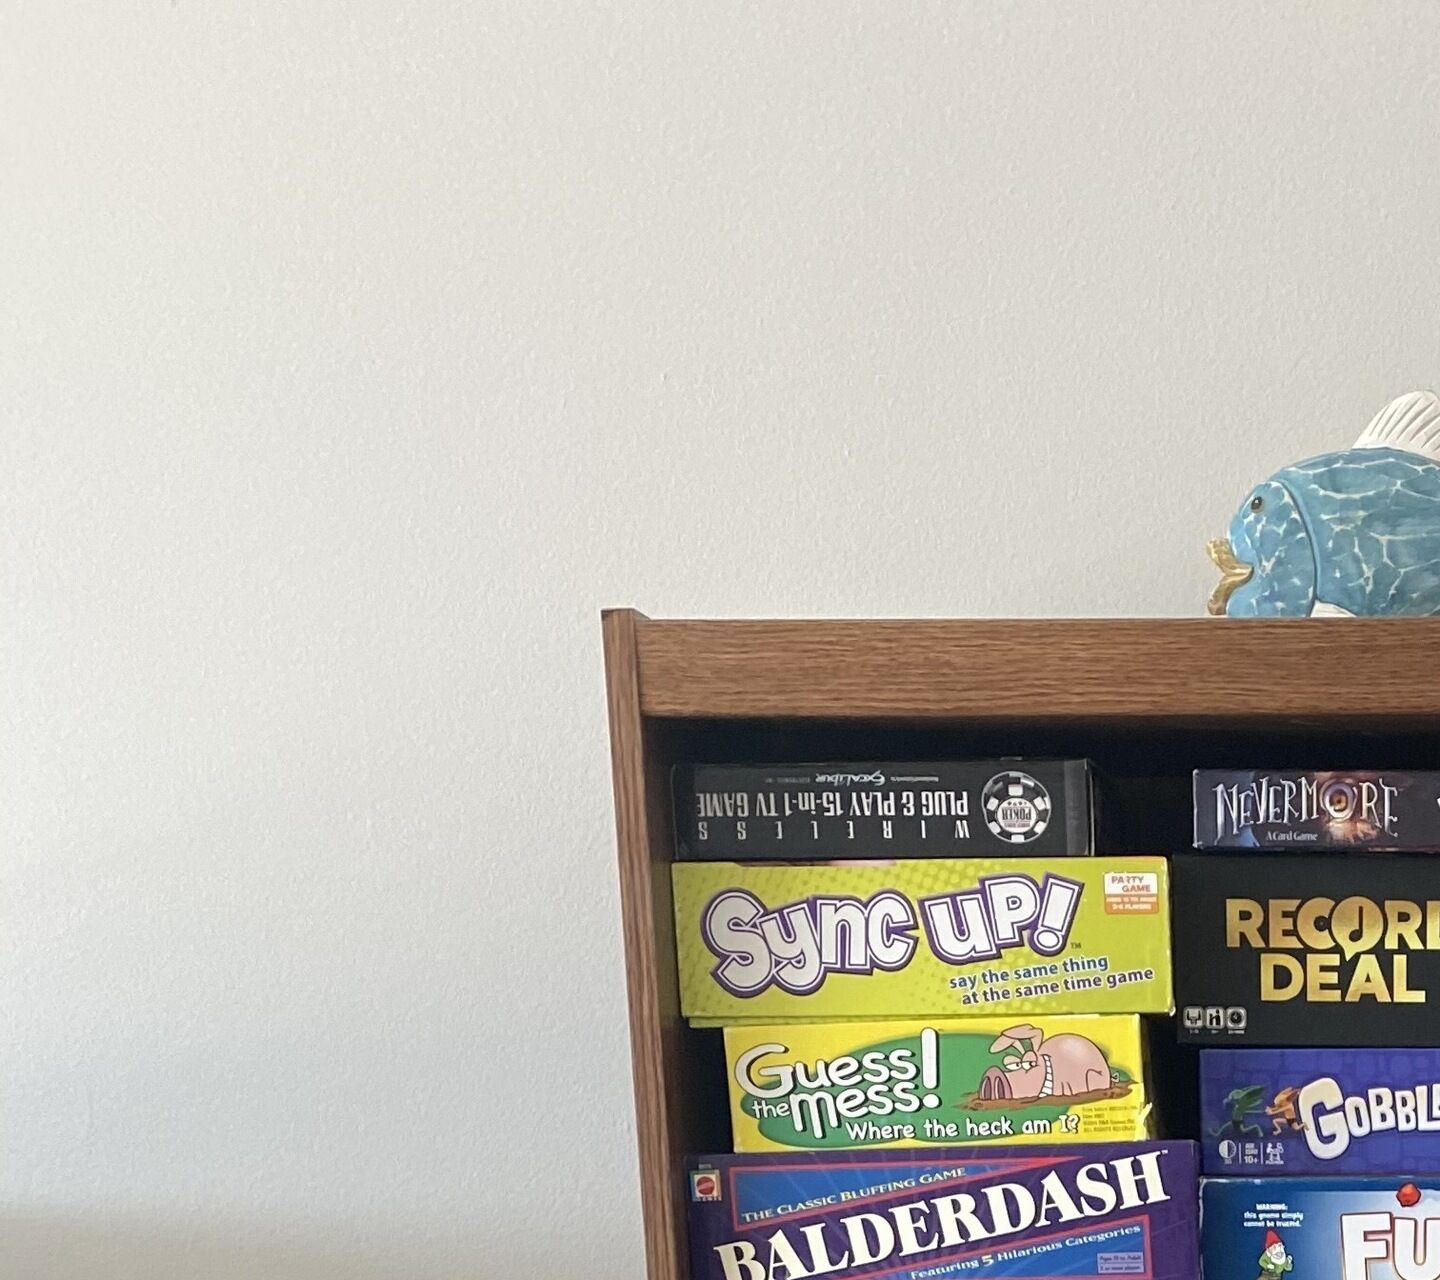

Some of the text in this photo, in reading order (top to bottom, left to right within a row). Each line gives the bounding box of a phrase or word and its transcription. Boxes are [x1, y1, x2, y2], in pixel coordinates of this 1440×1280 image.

[1212, 776, 1399, 846] NEVERMORE
[702, 889, 917, 996] Sync
[1260, 953, 1426, 1003] DEAL
[752, 1101, 791, 1119] the
[846, 1120, 900, 1141] Where
[923, 1121, 958, 1138] the
[966, 1118, 1012, 1136] heck
[1022, 1120, 1049, 1134] am
[1058, 1115, 1079, 1134] I?
[743, 1167, 966, 1223] THE CLASSIC BLUFFING GAME
